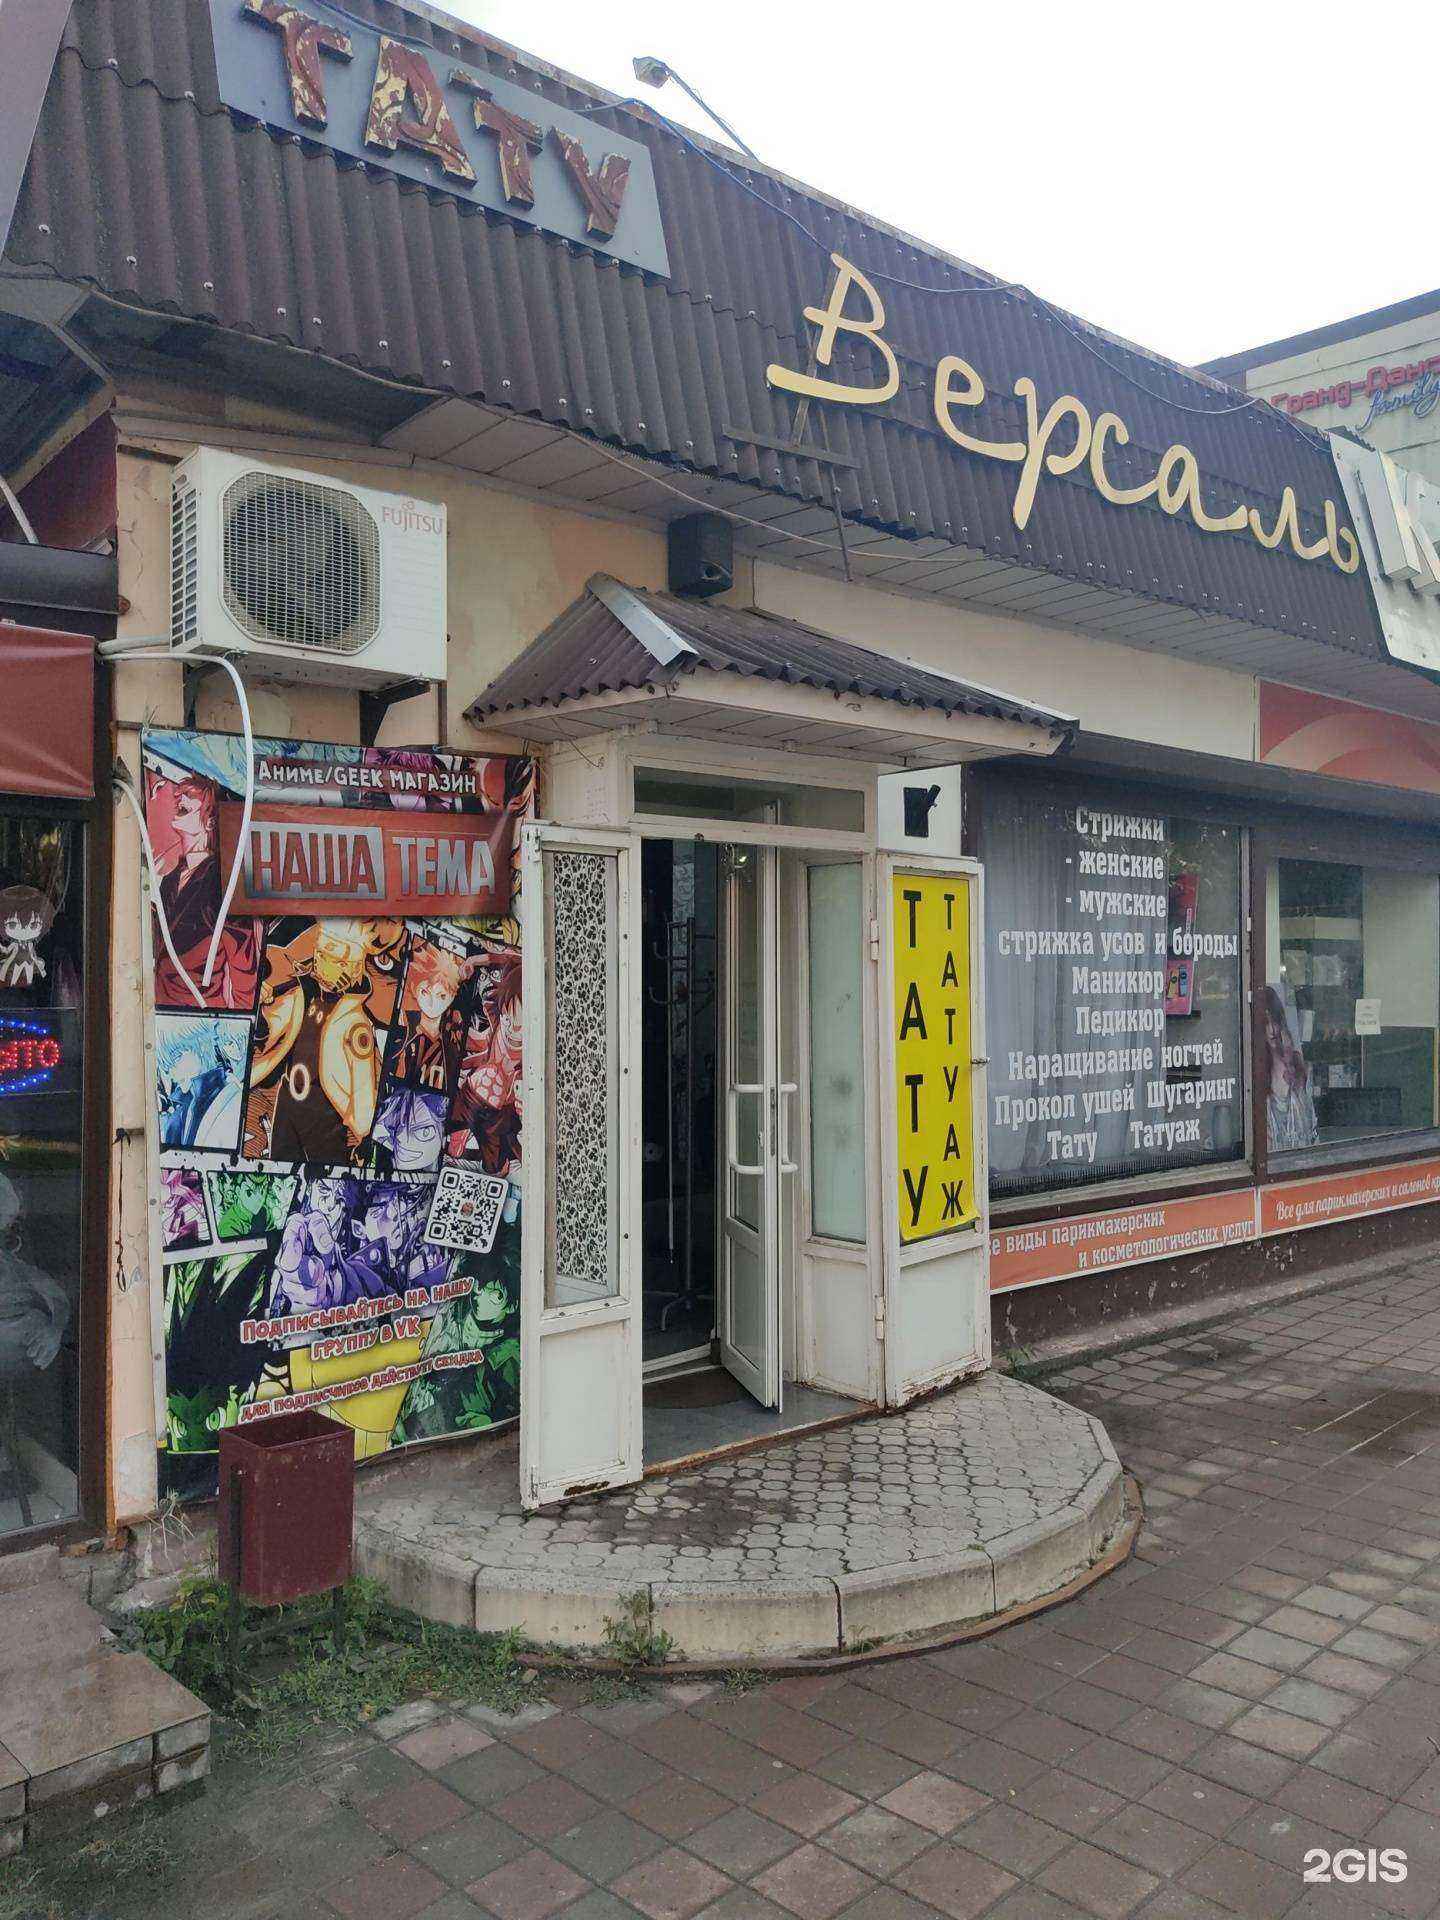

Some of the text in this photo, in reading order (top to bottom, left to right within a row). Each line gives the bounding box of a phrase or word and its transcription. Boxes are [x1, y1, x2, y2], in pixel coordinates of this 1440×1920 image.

[241, 0, 632, 242] ТАТУ
[766, 253, 1359, 574] Версаль
[382, 505, 444, 535] FUJITSU
[390, 771, 477, 795] МАГАЗИН
[1075, 806, 1165, 842] Стрижки
[248, 829, 496, 898] НАША ТЕМА
[1078, 851, 1164, 880] женские
[1079, 889, 1167, 920] мужские
[998, 926, 1238, 962] стрижка усов и бороды
[1072, 966, 1164, 999] Маникюр
[1075, 1006, 1164, 1037] Педикюр
[900, 889, 928, 1226] ТАТУ
[941, 893, 964, 1220] ТАТУАЖ
[1008, 1038, 1224, 1084] Наращивание ногтей
[995, 1077, 1236, 1131] Прокол ушей Шугаринг
[1047, 1118, 1200, 1162] Тату Татуаж
[1276, 1200, 1294, 1220] Все
[1295, 1200, 1314, 1222] для
[1006, 1230, 1047, 1253] виды
[1052, 1209, 1166, 1246] парикмахерских
[1078, 1219, 1255, 1269] и косметологических услуг
[407, 1288, 429, 1306] НА
[433, 1278, 474, 1301] НАШУ
[312, 1328, 378, 1359] ГРУППУ
